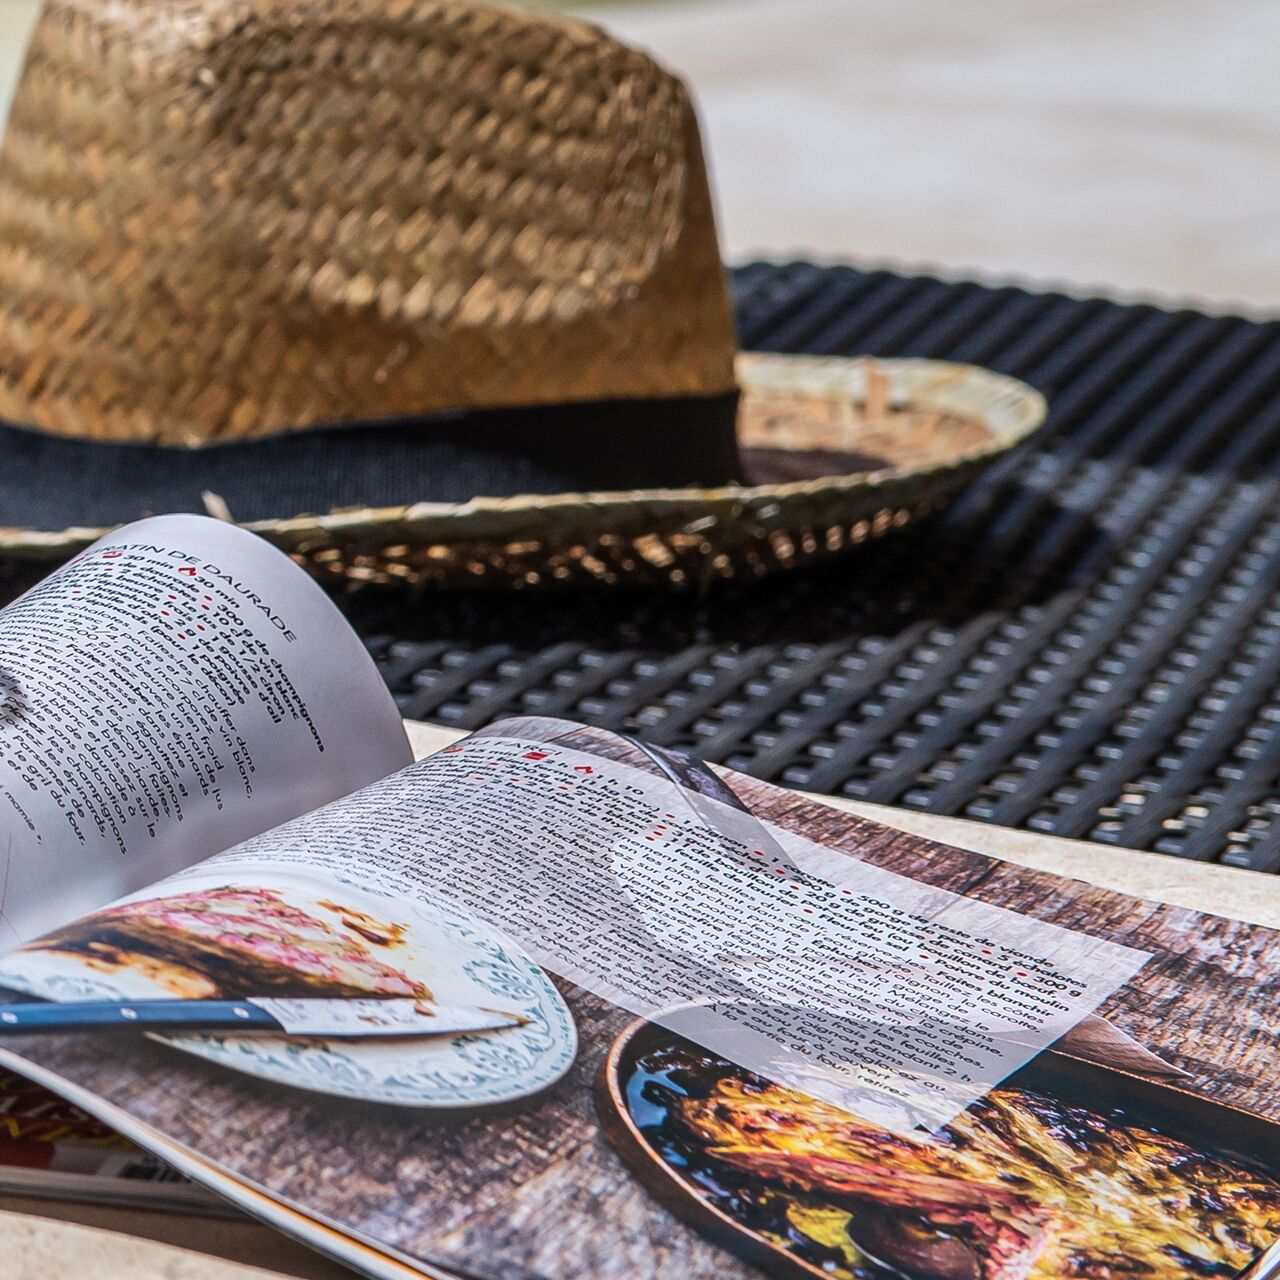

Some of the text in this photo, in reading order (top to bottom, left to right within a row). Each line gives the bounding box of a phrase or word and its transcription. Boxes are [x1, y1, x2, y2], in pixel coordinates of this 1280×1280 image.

[146, 559, 240, 608] min 30 min
[167, 550, 201, 564] DE
[202, 563, 296, 642] DAURADE
[61, 603, 255, 772] échalotes. Faites-les chauffer dans
[85, 584, 156, 608] chapelure
[197, 638, 214, 652] de
[213, 654, 250, 694] poivre
[115, 574, 285, 715] beurre Le jus de 1/2 citron
[126, 603, 173, 630] d'olive
[198, 653, 244, 704] poignée
[132, 572, 299, 719] échalotes 10 cl de vin blanc
[139, 566, 324, 752] daurade 300 g de champignons
[149, 625, 187, 652] (pour
[186, 653, 199, 664] le
[200, 666, 236, 705] décor)
[162, 600, 193, 621] frais
[218, 645, 258, 688] gousse
[258, 691, 281, 723] d'ail
[31, 698, 136, 816] filets de daurade à
[37, 680, 159, 821] casserole bien chaude.
[47, 665, 105, 703] émincez
[106, 704, 123, 721] les
[125, 724, 183, 821] champignons
[65, 643, 209, 795] Faites tomber les épinards
[0, 702, 126, 854] Placez les champignons
[4, 791, 35, 830] mamie
[13, 749, 26, 762] le
[26, 764, 52, 786] gril
[49, 789, 65, 807] du
[65, 810, 85, 845] four.
[624, 785, 644, 795] 10
[574, 784, 635, 809] poitrine
[638, 809, 658, 818] de
[660, 819, 714, 843] cochon
[717, 842, 769, 867] séchée
[790, 875, 822, 891] 200
[839, 897, 860, 906] de
[862, 907, 911, 925] gorge
[914, 925, 935, 934] de
[936, 934, 975, 949] porc
[1012, 960, 1087, 988] échalotes
[599, 784, 620, 796] kg
[623, 795, 660, 812] env.)
[694, 825, 747, 849] oignon
[782, 864, 835, 888] carotte
[856, 895, 890, 909] 500
[907, 914, 929, 924] de
[931, 923, 971, 938] reste
[974, 938, 995, 947] de
[999, 946, 1054, 967] viande
[684, 837, 745, 866] gousses
[748, 866, 786, 883] d'ail
[804, 890, 827, 902] 20
[844, 908, 865, 917] de
[867, 917, 925, 940] graisse
[928, 939, 950, 949] de
[953, 948, 1013, 971] canard
[1032, 975, 1067, 990] 300
[745, 882, 1069, 1011] laurier Fleur de sel Poivre du moulin
[800, 899, 1057, 998] pot-au-feu (ou bouillon de bœuf,
[923, 973, 1043, 1023] Taillez les côtes
[935, 970, 1054, 1016] Faites blanchir
[721, 1010, 738, 1021] la
[741, 1021, 786, 1043] sortie
[790, 1043, 812, 1055] du
[815, 1053, 849, 1075] four,
[857, 1074, 910, 1097] retirez
[868, 1038, 940, 1069] pendant
[942, 1067, 957, 1076] 2
[886, 989, 989, 1030] Mélangez le
[960, 998, 976, 1008] la
[980, 1007, 1040, 1032] carotte,
